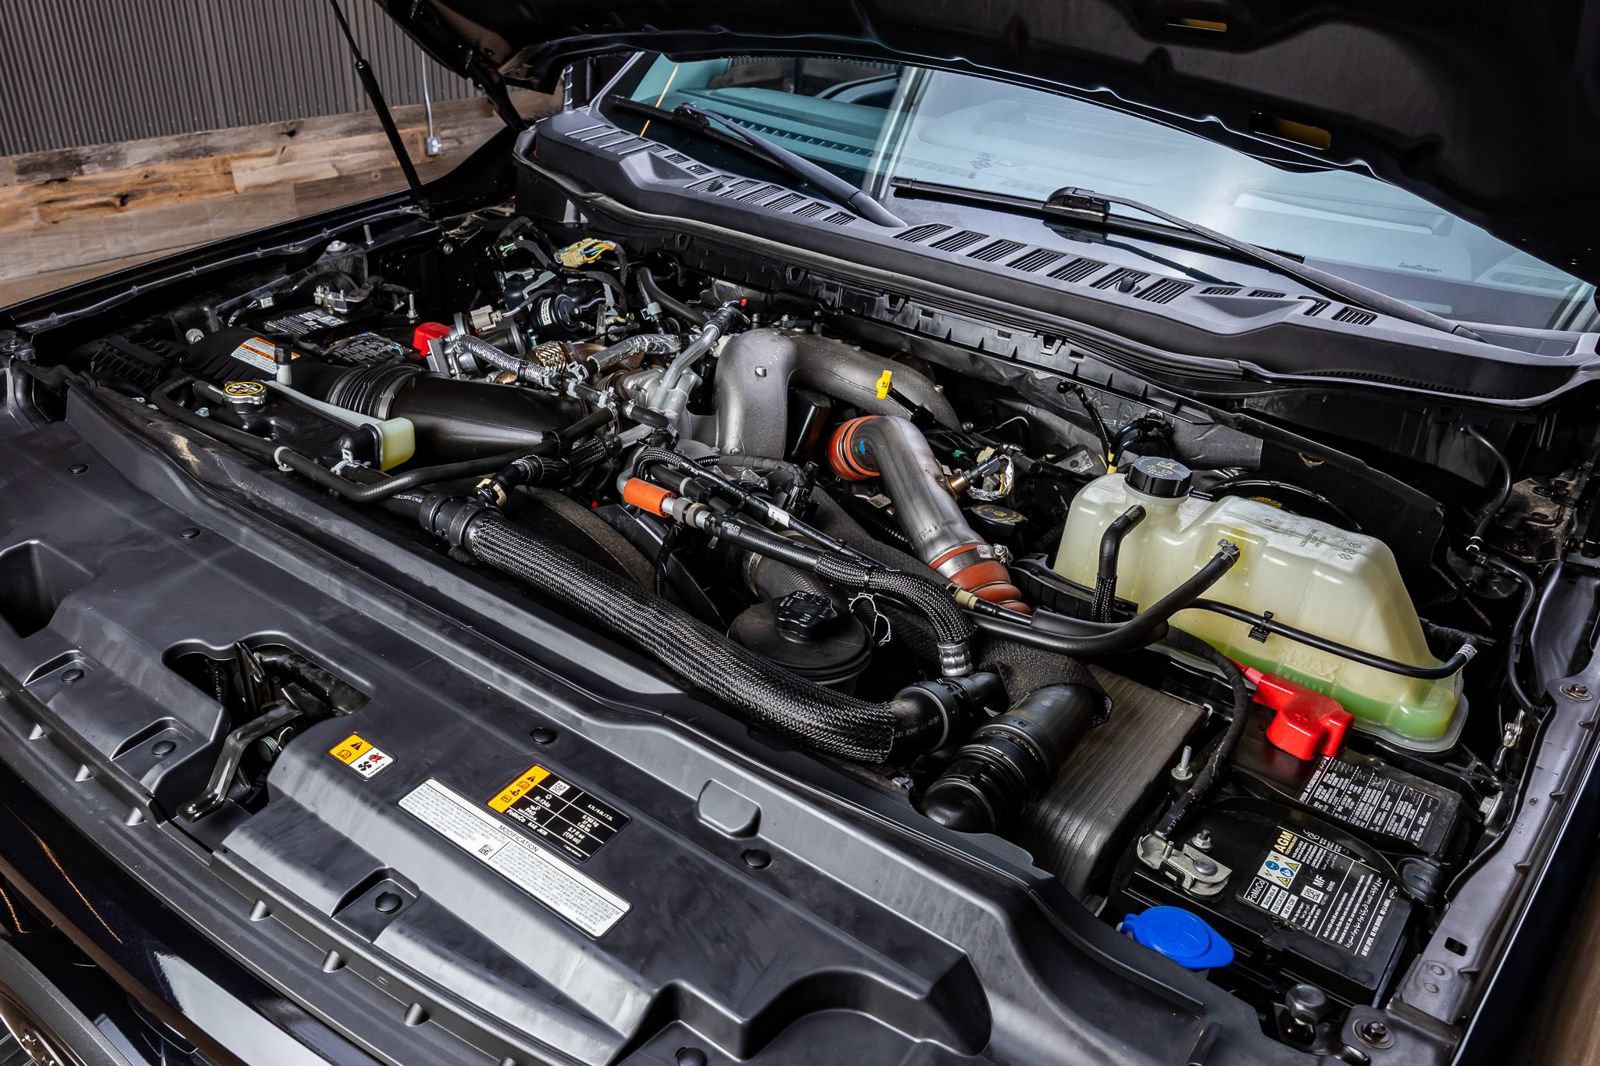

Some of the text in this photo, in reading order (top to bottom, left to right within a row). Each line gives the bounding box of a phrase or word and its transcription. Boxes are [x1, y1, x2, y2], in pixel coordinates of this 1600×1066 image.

[499, 825, 538, 852] MODIFICATION
[1275, 831, 1292, 852] AGM
[1247, 881, 1265, 902] FoMoCo
[1313, 875, 1325, 887] MF
